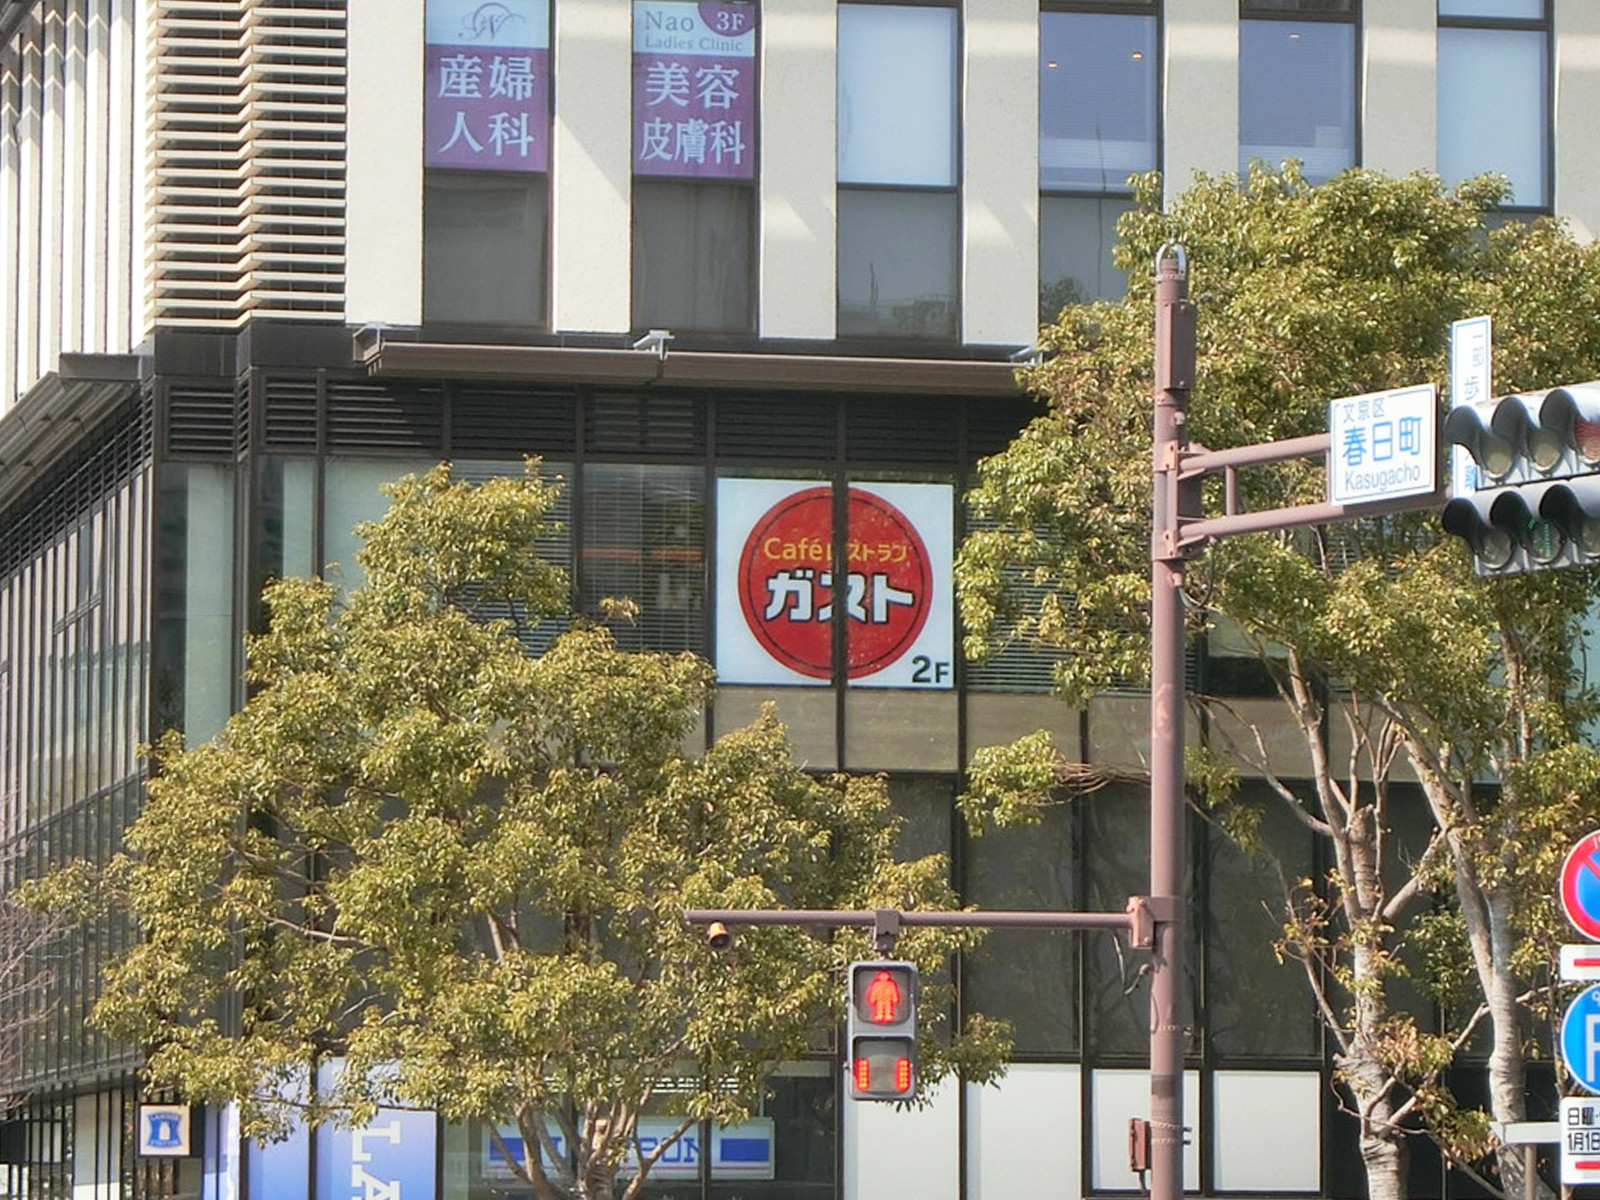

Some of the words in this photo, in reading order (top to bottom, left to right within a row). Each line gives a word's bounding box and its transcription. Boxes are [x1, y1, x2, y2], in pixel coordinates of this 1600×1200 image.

[645, 11, 694, 32] Nao
[717, 11, 745, 31] 3F
[645, 34, 694, 49] Ladies
[699, 37, 743, 52] Clinic
[438, 54, 535, 101] 産婦
[645, 62, 739, 109] 美容
[438, 111, 534, 157] 人科
[639, 117, 745, 165] 皮膚科
[1343, 398, 1385, 423] 文京区
[1343, 416, 1422, 467] 春日町
[1345, 462, 1421, 493] Kasugacho
[764, 567, 916, 624] ガスト
[911, 654, 949, 684] 2F
